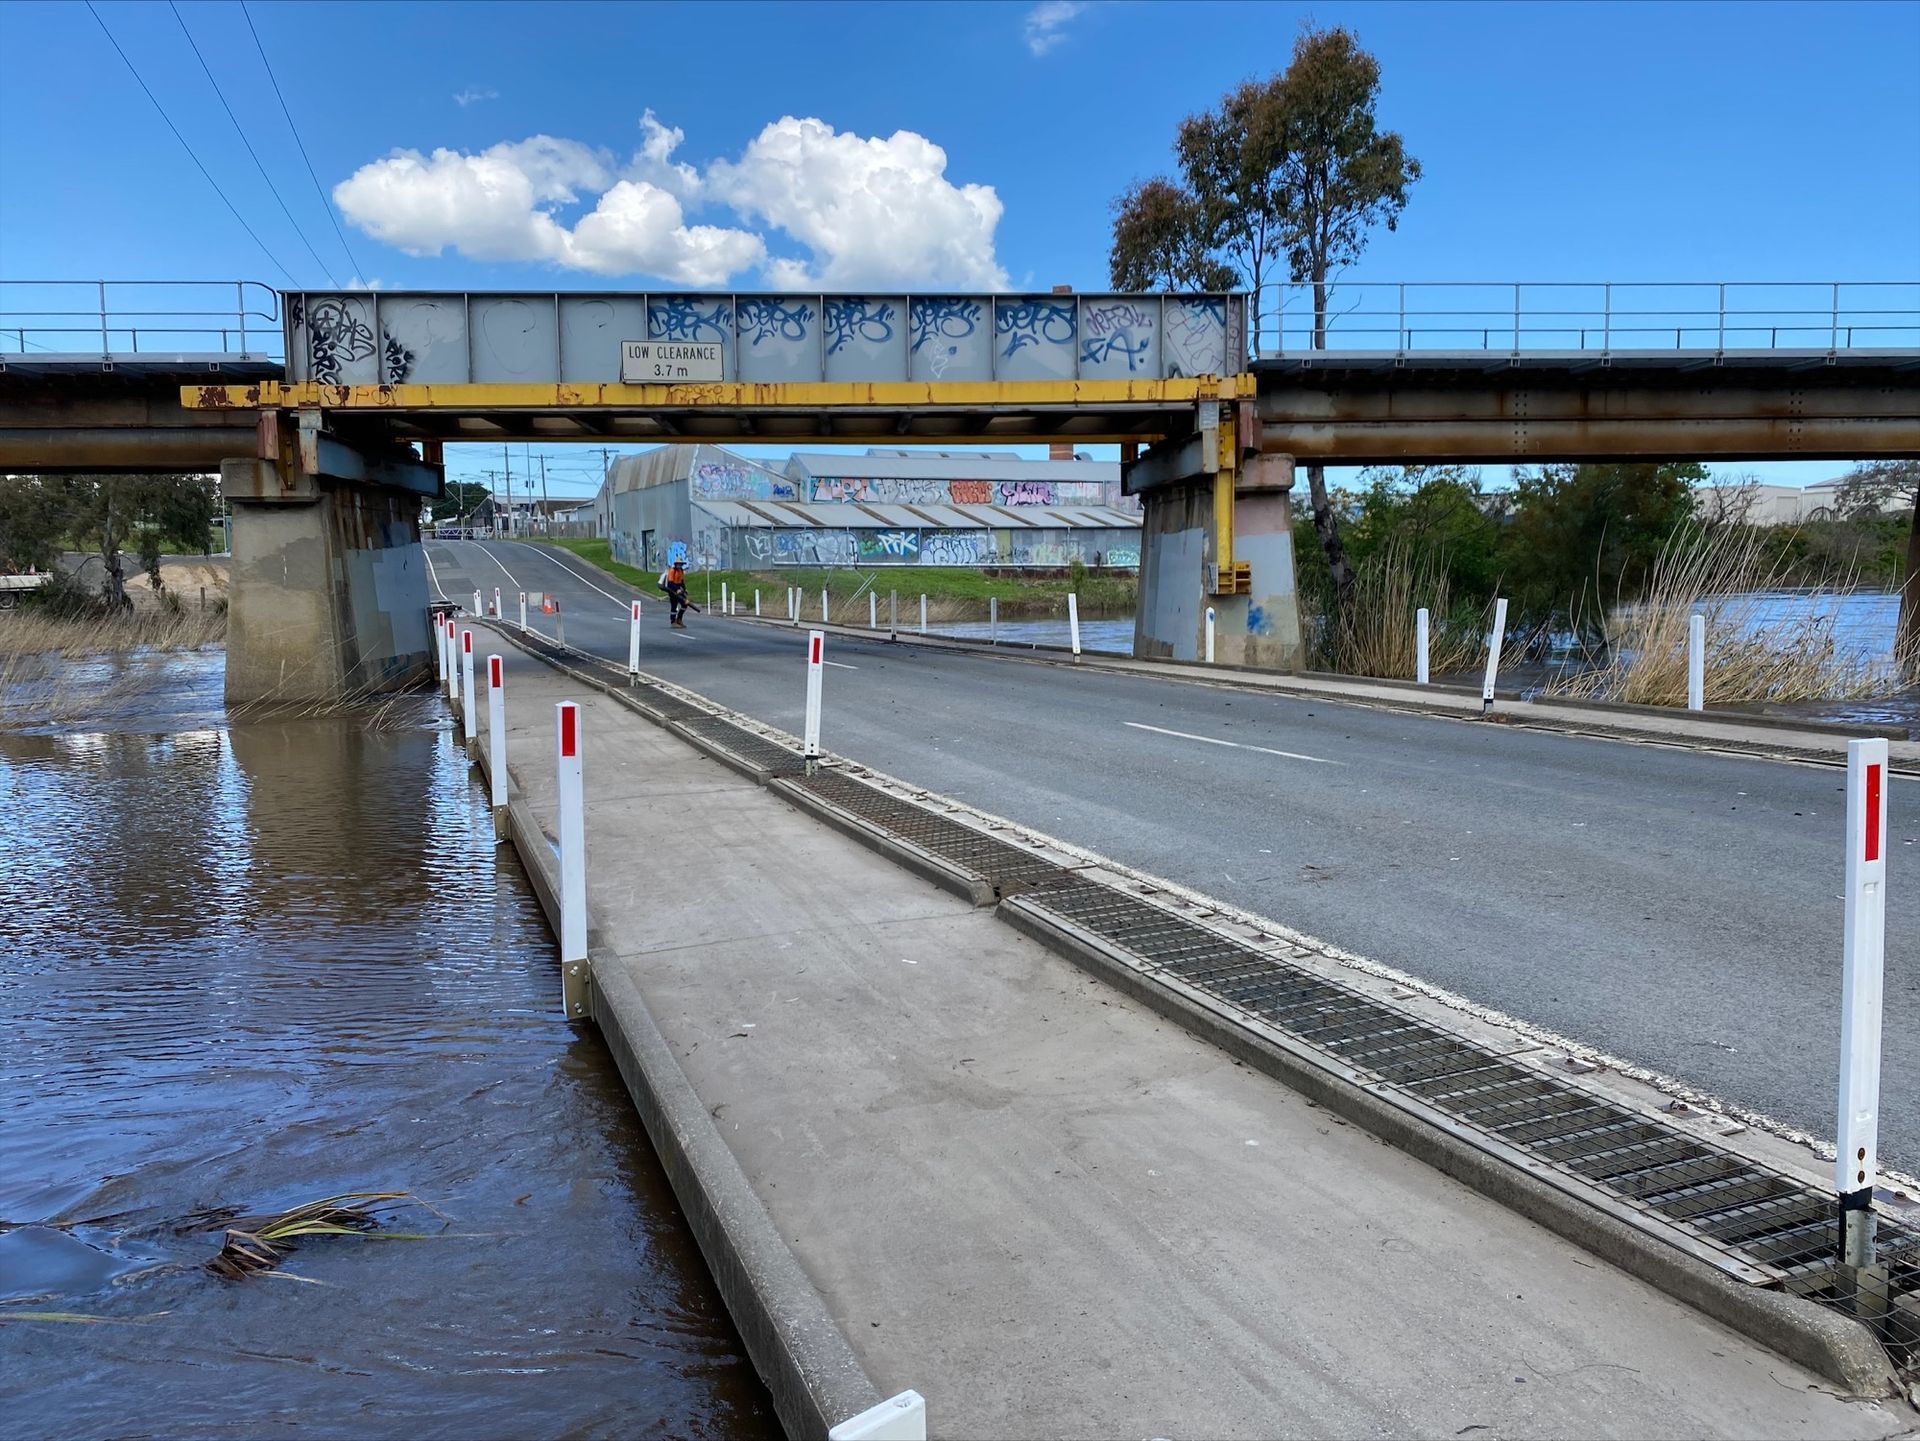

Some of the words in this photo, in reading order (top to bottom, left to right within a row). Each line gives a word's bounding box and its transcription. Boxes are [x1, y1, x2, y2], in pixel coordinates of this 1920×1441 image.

[629, 346, 649, 359] LOW
[657, 346, 716, 360] CLEARANCE
[654, 364, 673, 376] 3.7
[677, 367, 688, 377] m
